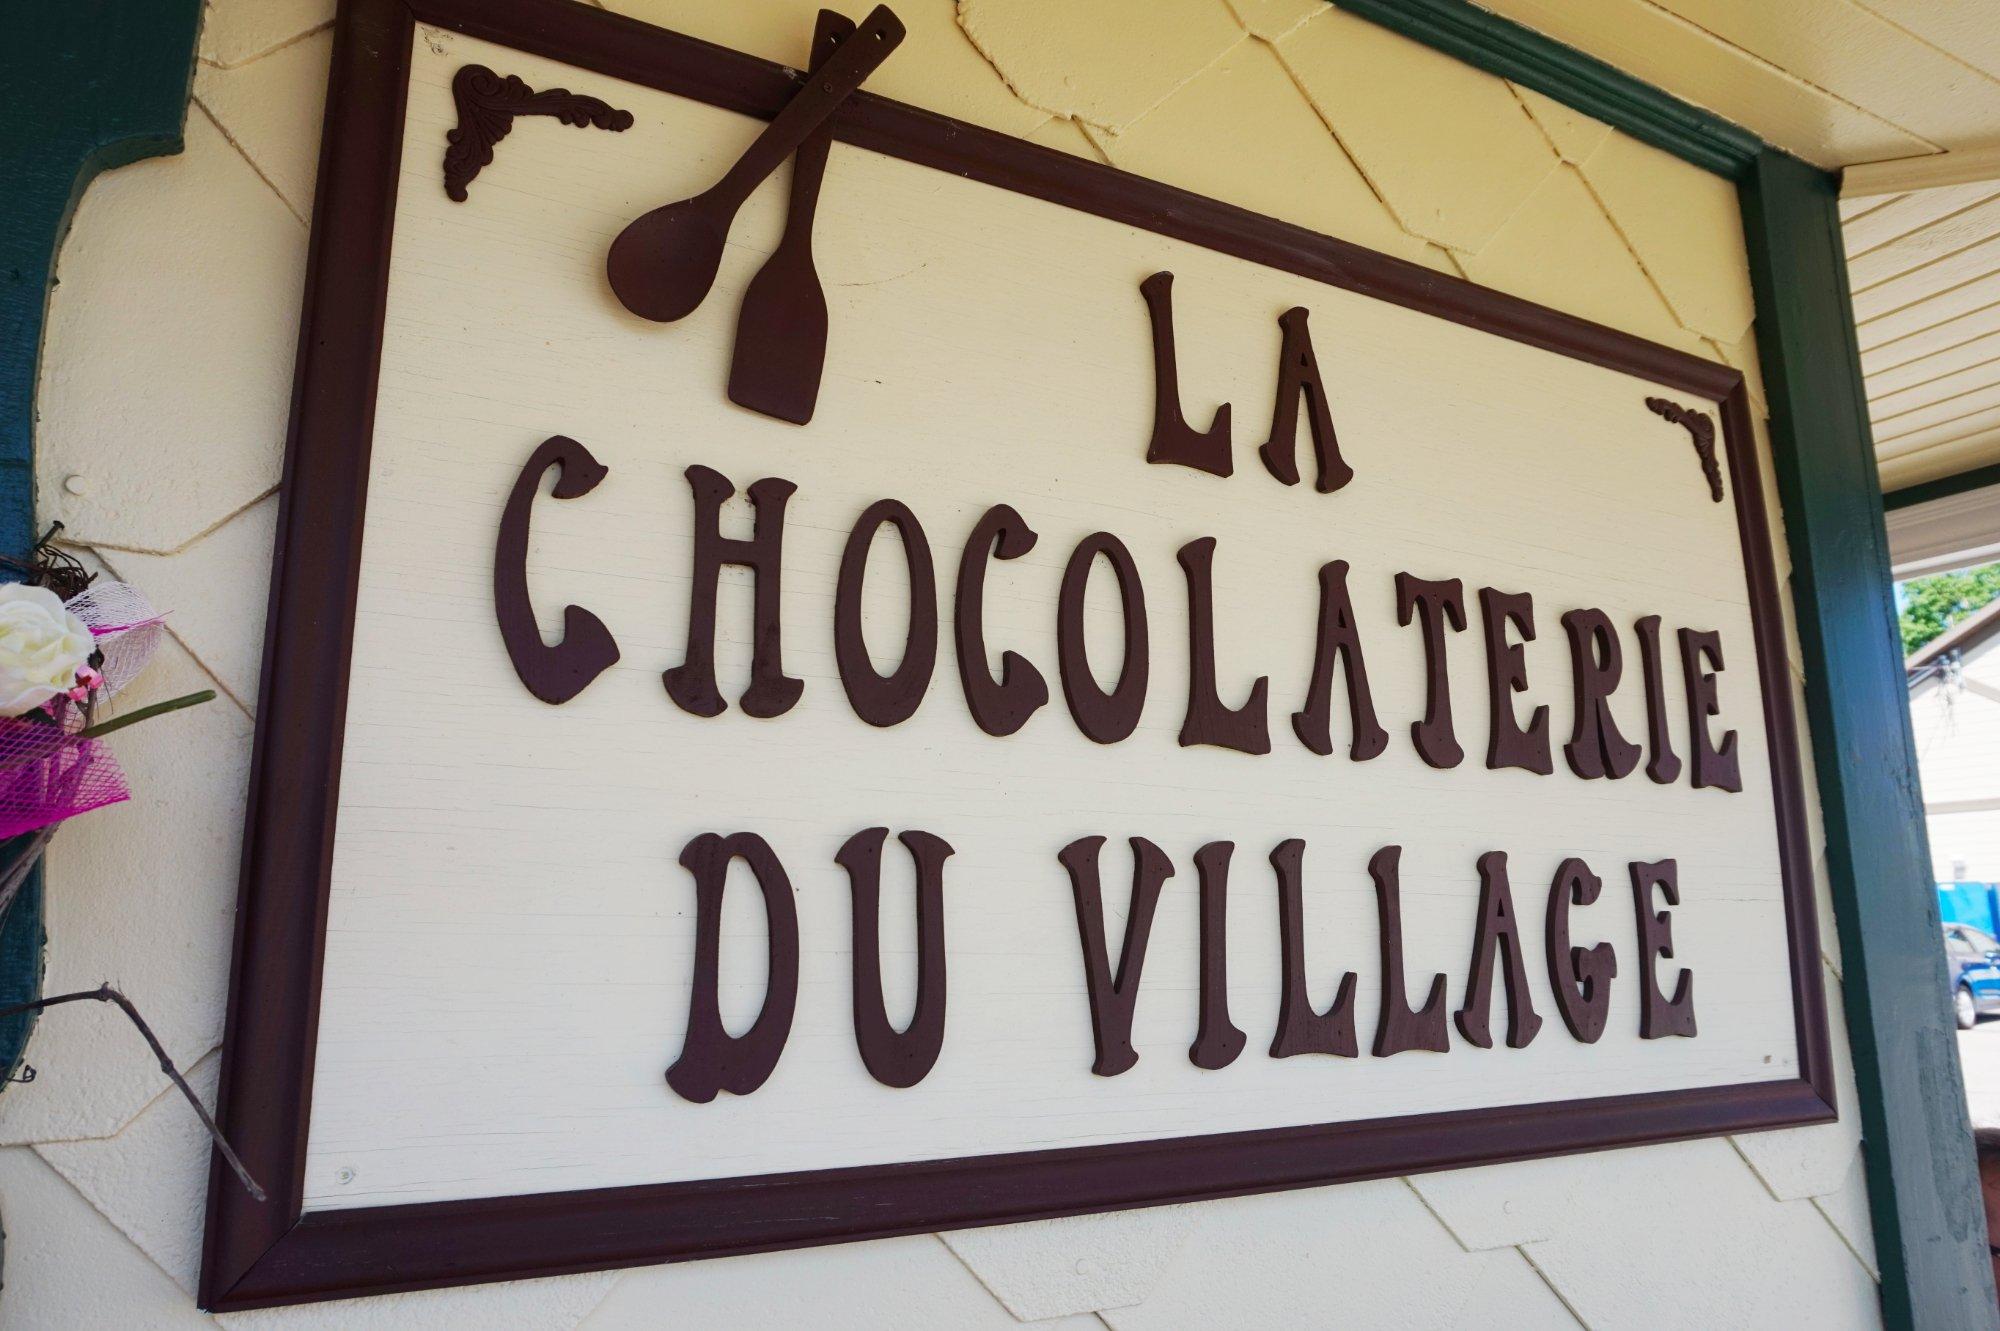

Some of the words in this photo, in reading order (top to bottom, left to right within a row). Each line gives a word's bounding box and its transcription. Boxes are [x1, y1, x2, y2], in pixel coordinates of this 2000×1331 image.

[1139, 271, 1353, 494] LA
[494, 435, 1742, 793] CHOCOLATERIE
[665, 827, 955, 1104] DU
[1058, 836, 1696, 1077] VILLAGE
